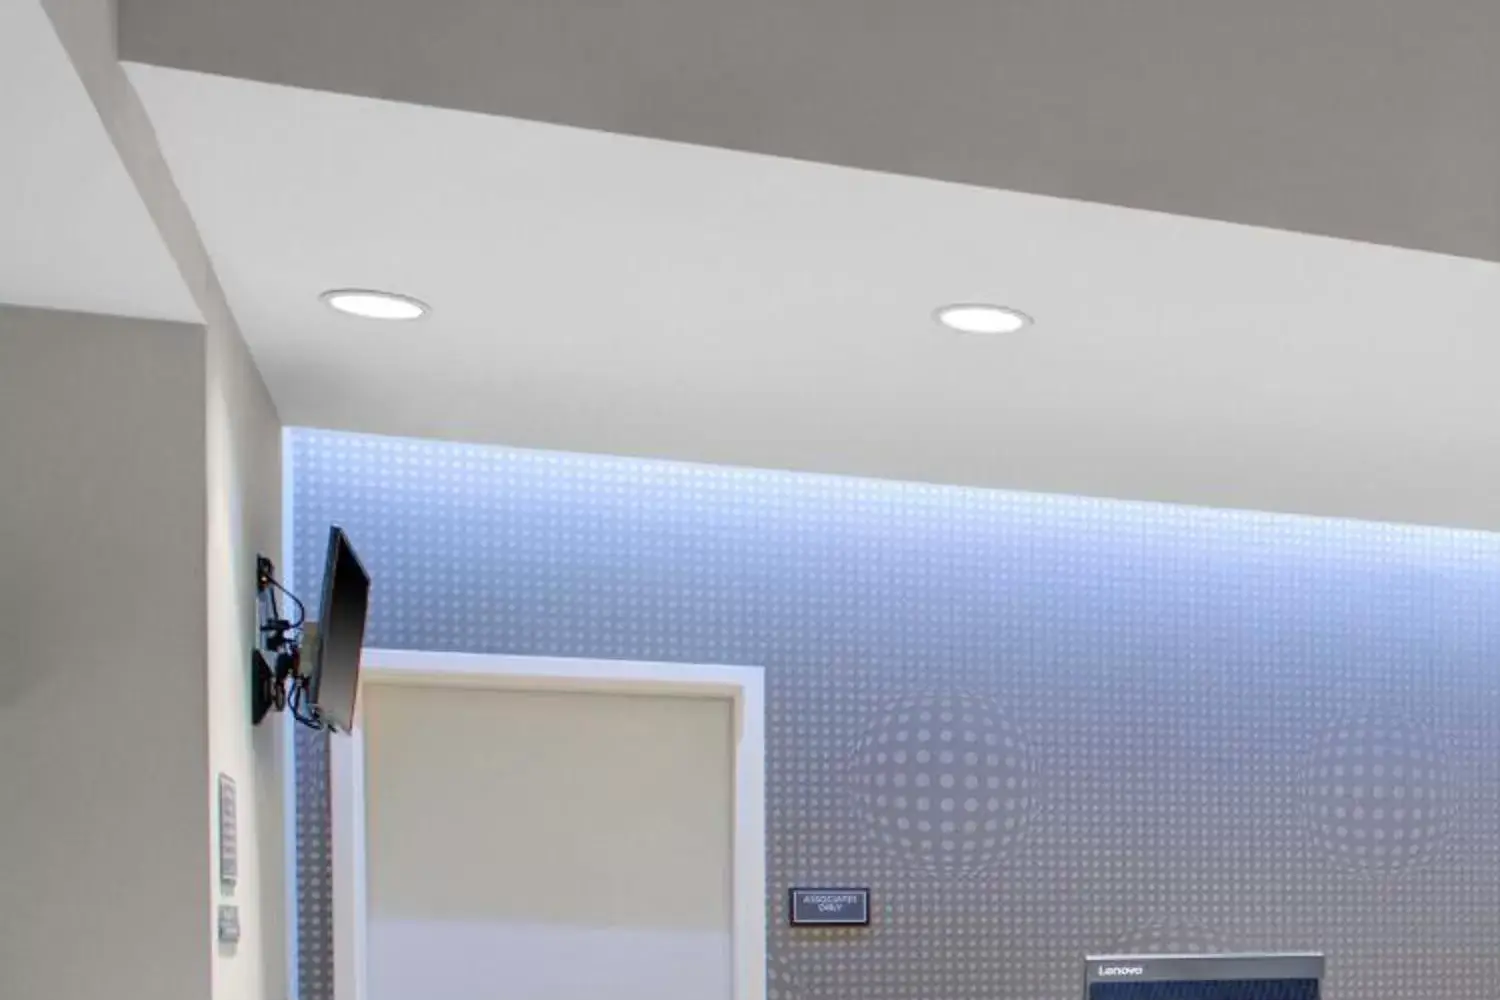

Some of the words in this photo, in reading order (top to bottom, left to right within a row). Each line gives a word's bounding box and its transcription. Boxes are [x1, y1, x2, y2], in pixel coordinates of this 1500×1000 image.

[802, 895, 857, 904] ASSOCIATES
[818, 903, 843, 912] ONLY
[1098, 965, 1143, 976] Lenovo
